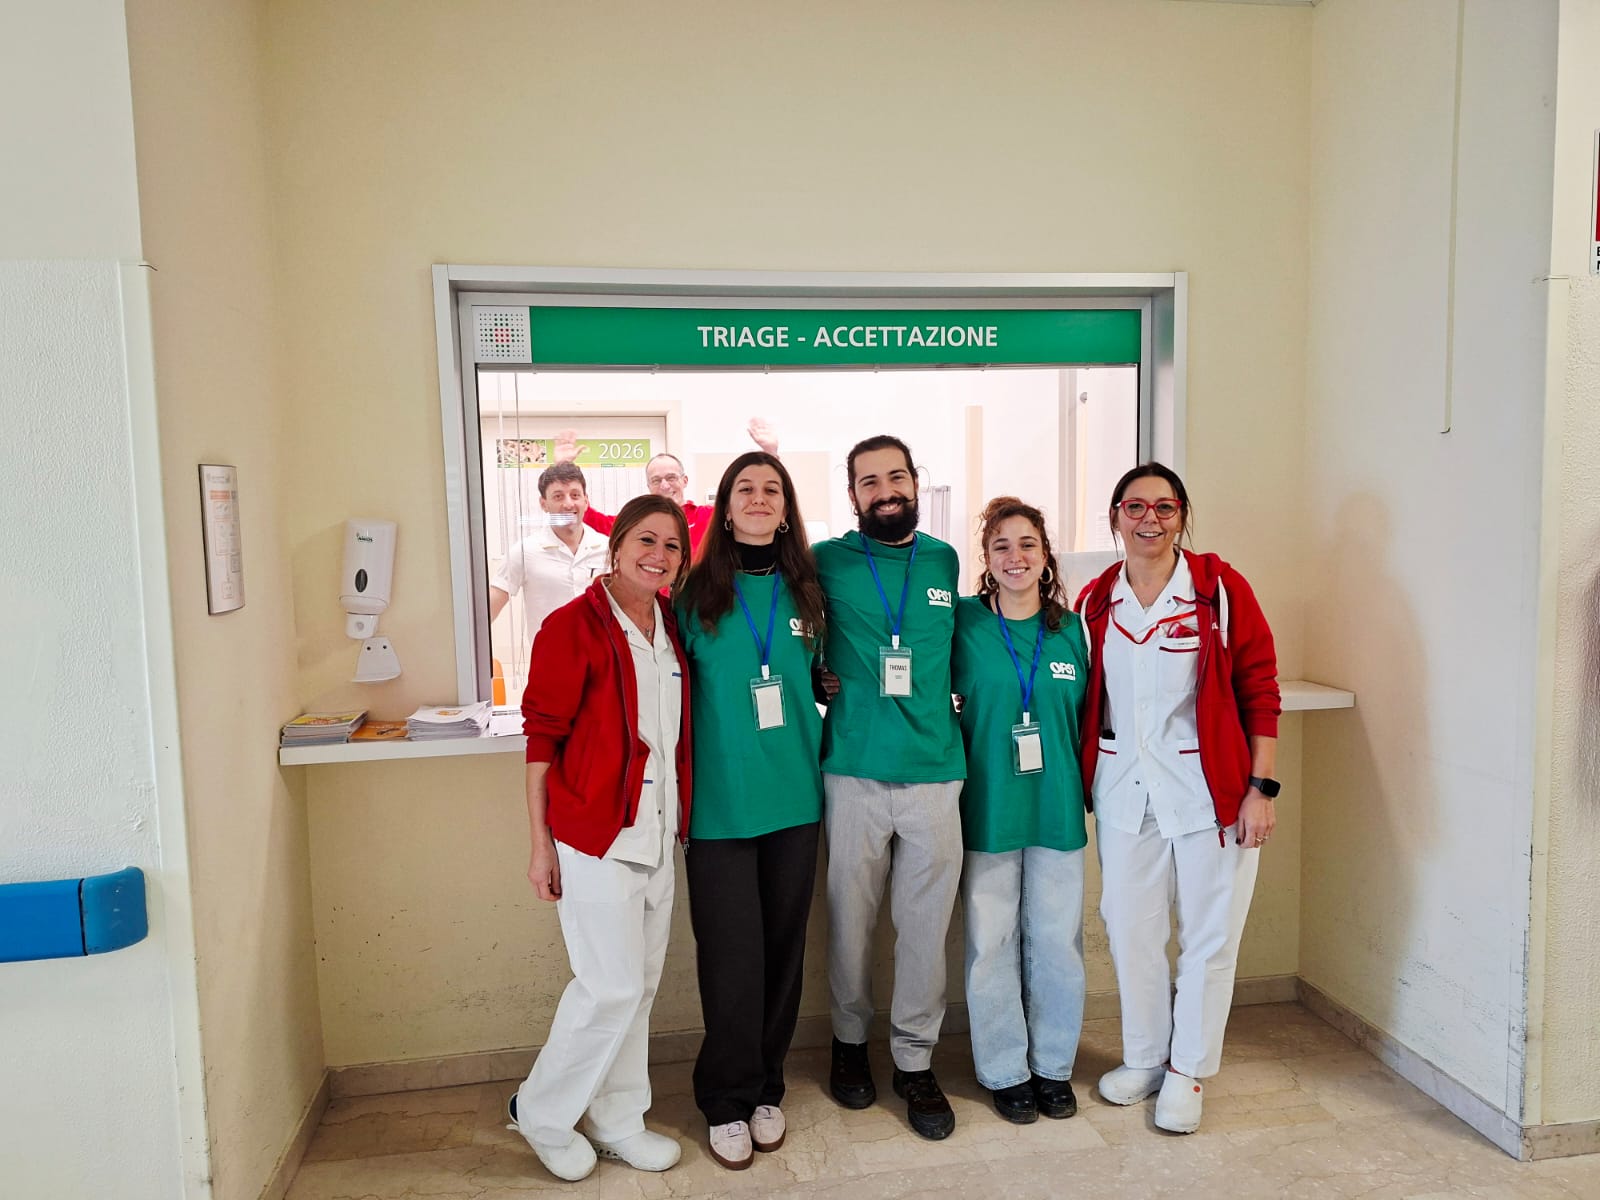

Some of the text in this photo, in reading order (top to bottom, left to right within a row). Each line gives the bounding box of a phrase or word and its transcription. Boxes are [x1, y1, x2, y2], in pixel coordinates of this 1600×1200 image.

[697, 326, 789, 348] TRIAGE
[813, 326, 998, 347] ACCETTAZIONE
[599, 443, 644, 459] 2026
